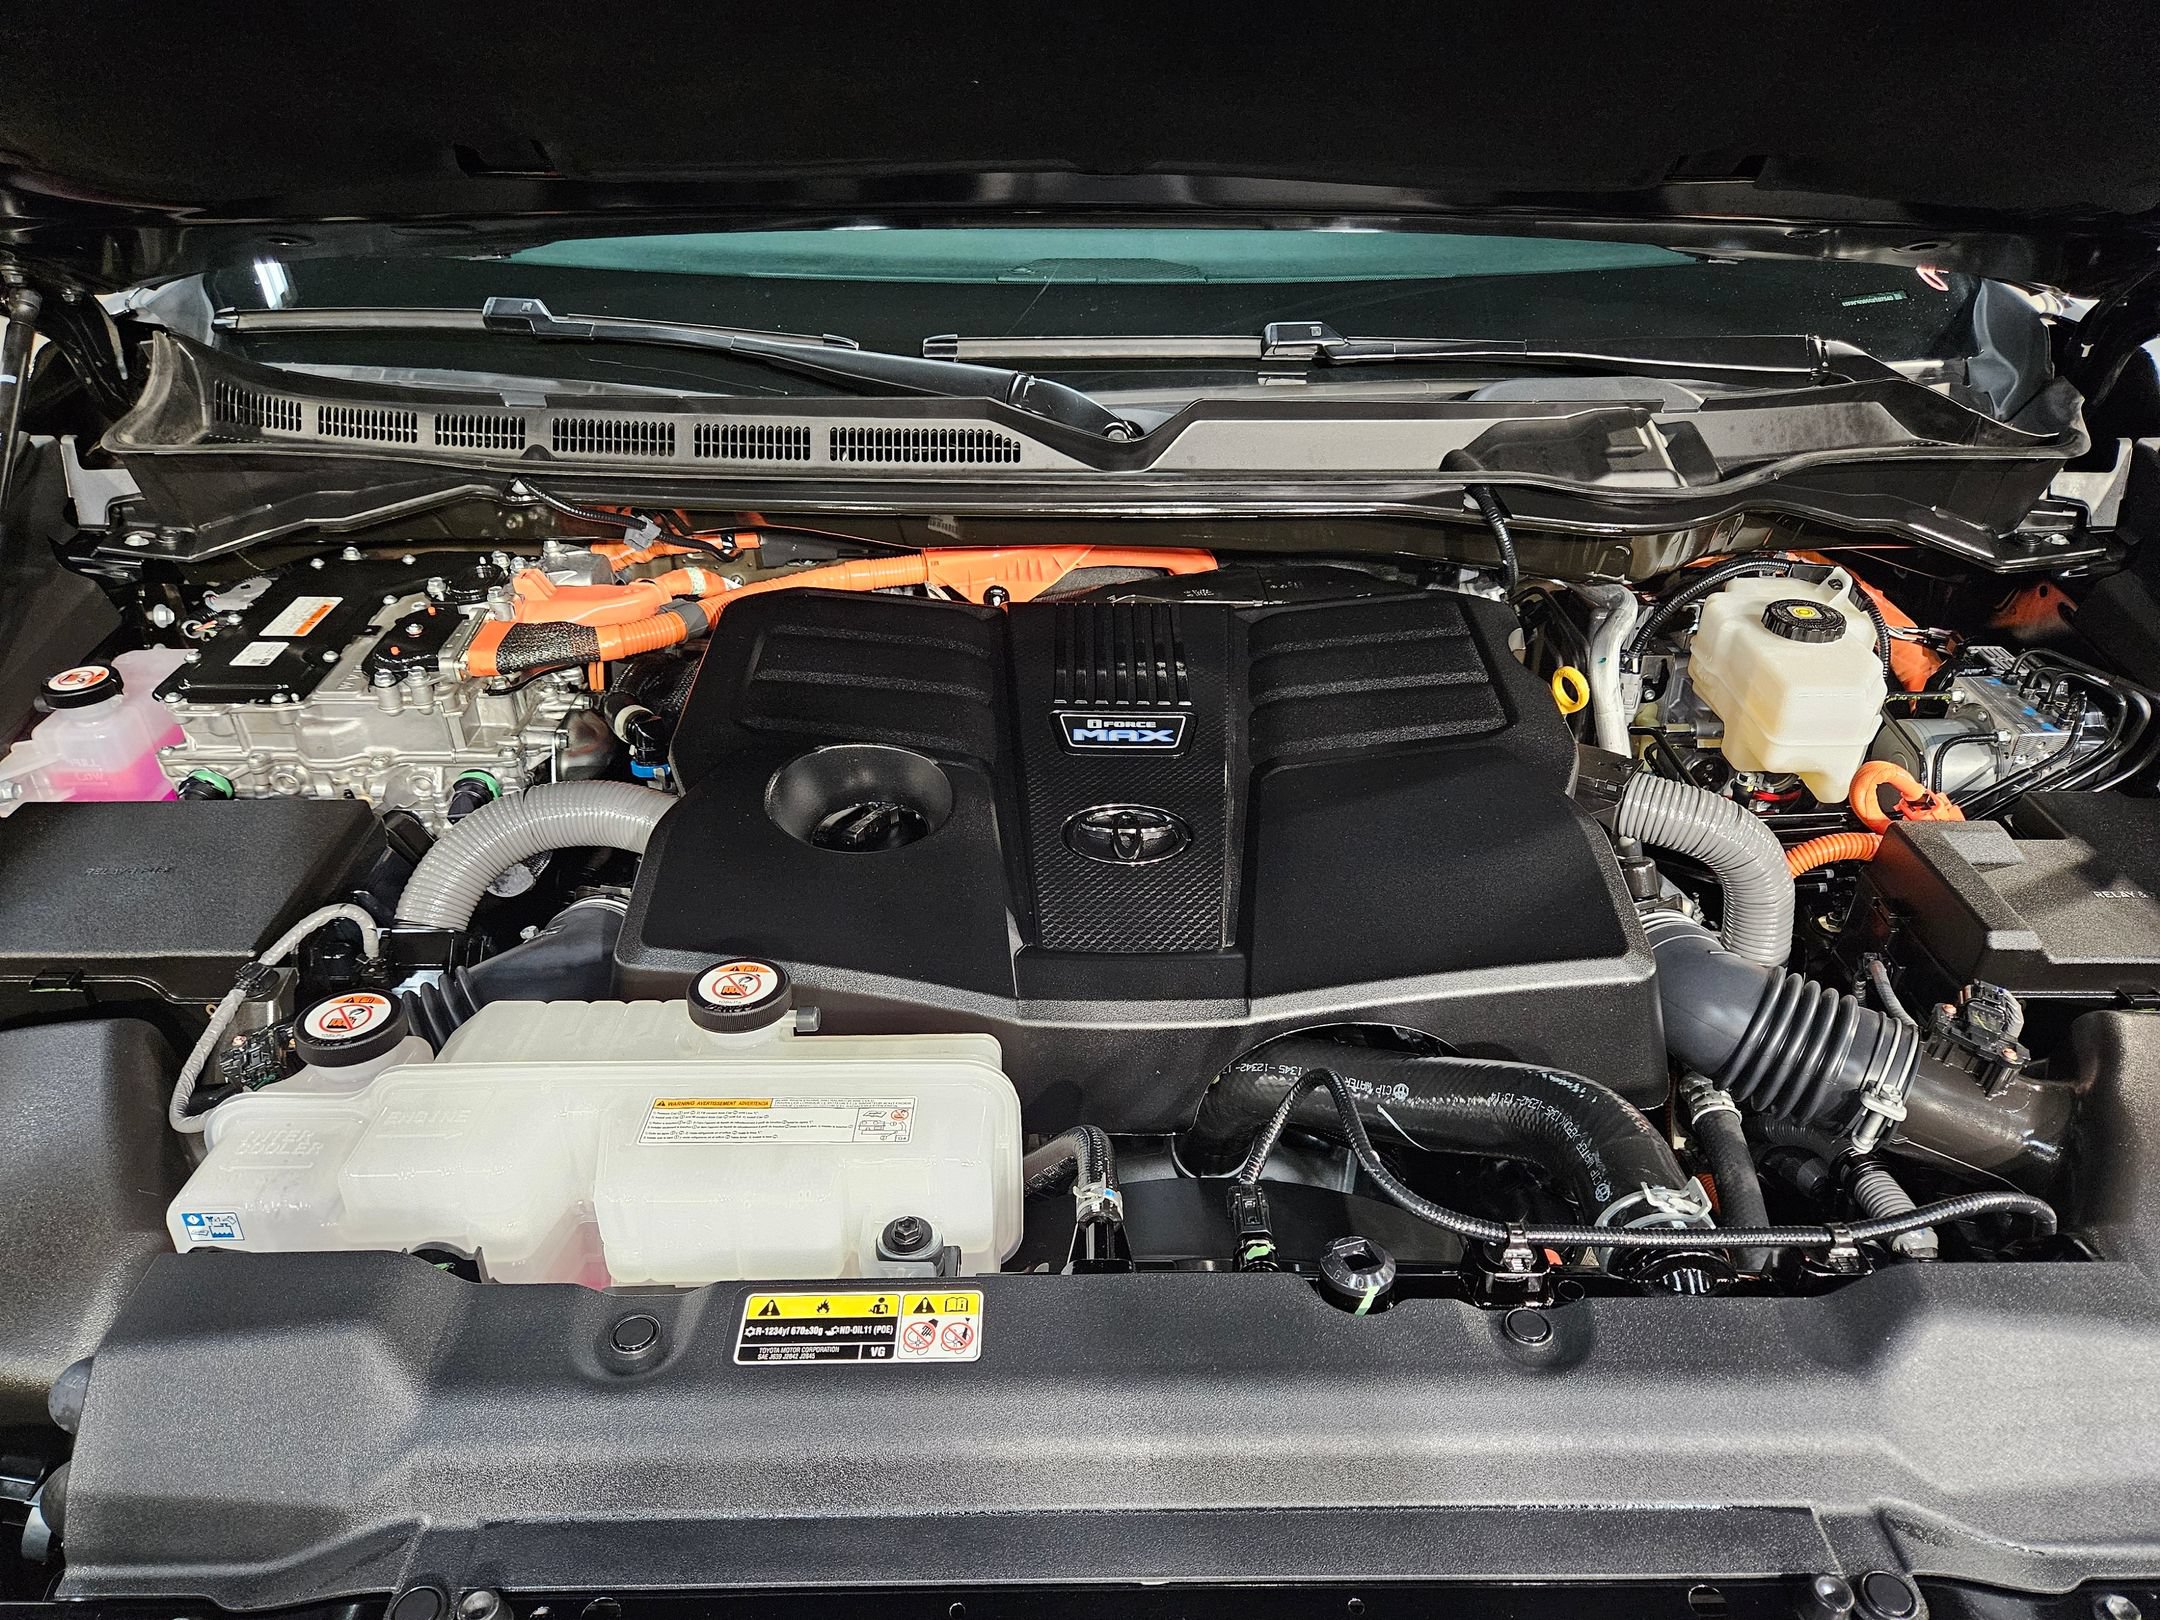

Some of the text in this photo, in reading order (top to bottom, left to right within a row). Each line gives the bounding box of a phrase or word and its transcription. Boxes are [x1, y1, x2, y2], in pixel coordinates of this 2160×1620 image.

[1073, 728, 1175, 742] MAX
[2092, 890, 2135, 899] RELAY
[382, 1109, 472, 1125] ENGINE
[241, 1129, 315, 1144] INTER
[236, 1141, 324, 1155] COOLER
[873, 1324, 894, 1336] (POE)
[870, 1346, 886, 1357] VG
